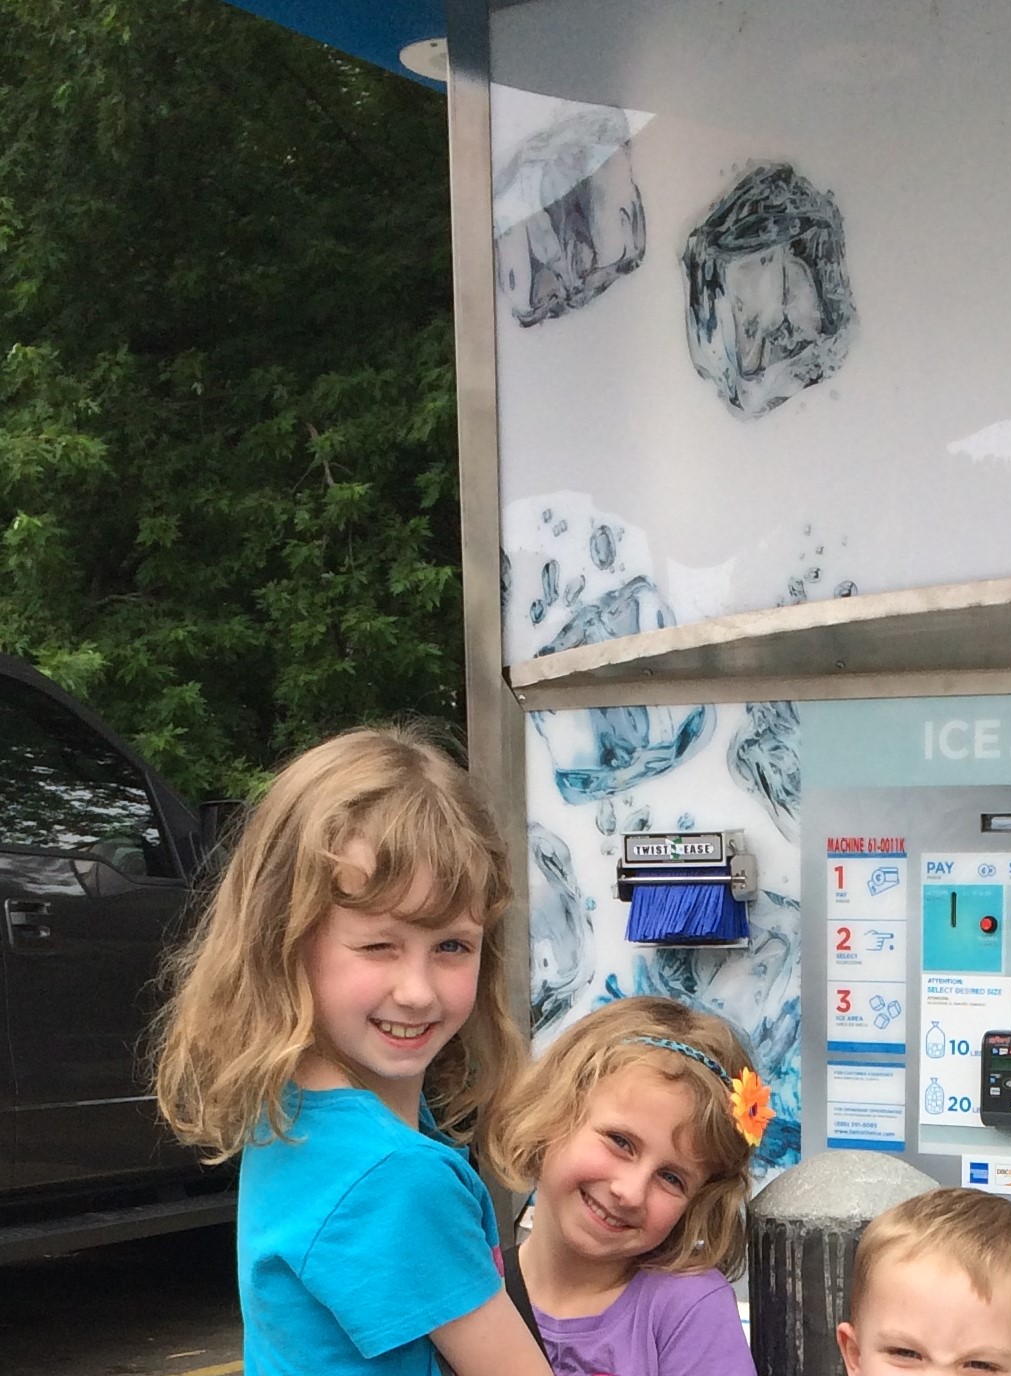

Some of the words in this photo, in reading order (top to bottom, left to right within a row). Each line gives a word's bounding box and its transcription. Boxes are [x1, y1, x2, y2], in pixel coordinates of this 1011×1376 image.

[924, 719, 1000, 760] ICE
[636, 845, 668, 855] TWIST
[684, 844, 710, 854] EASE
[827, 837, 864, 853] MACHINE
[868, 837, 905, 853] 61-0011K
[927, 861, 954, 874] PAY
[834, 865, 844, 889] 1
[836, 927, 851, 951] 2
[928, 986, 953, 994] SELECT
[836, 989, 851, 1013] 3
[949, 1040, 970, 1055] 10
[948, 1096, 972, 1112] 20
